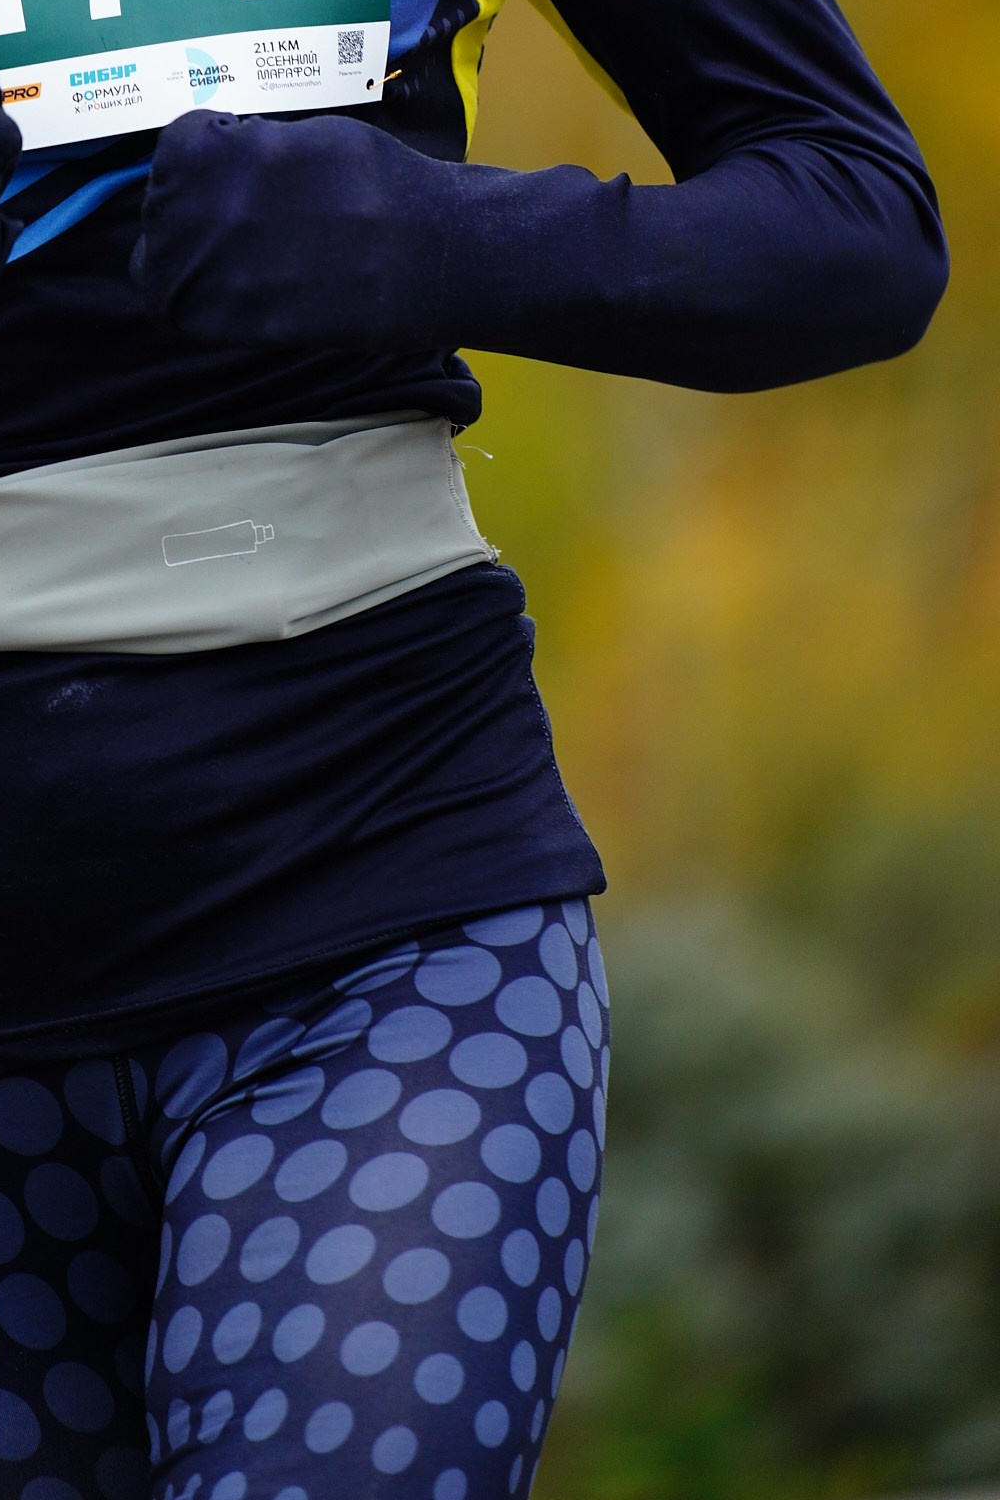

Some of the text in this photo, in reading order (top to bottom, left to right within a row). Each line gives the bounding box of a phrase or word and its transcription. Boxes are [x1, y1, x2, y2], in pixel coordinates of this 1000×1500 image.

[253, 41, 275, 54] 21.1
[255, 50, 318, 68] ОСЕННИЙ
[69, 63, 137, 87] СИБУР
[188, 64, 229, 78] РАДИО
[257, 65, 321, 80] МАРАФОН
[189, 74, 235, 87] СИБИРЬ
[2, 86, 39, 101] PRO
[72, 83, 140, 103] ФОРМУЛА
[124, 95, 143, 106] ДЕЛ
